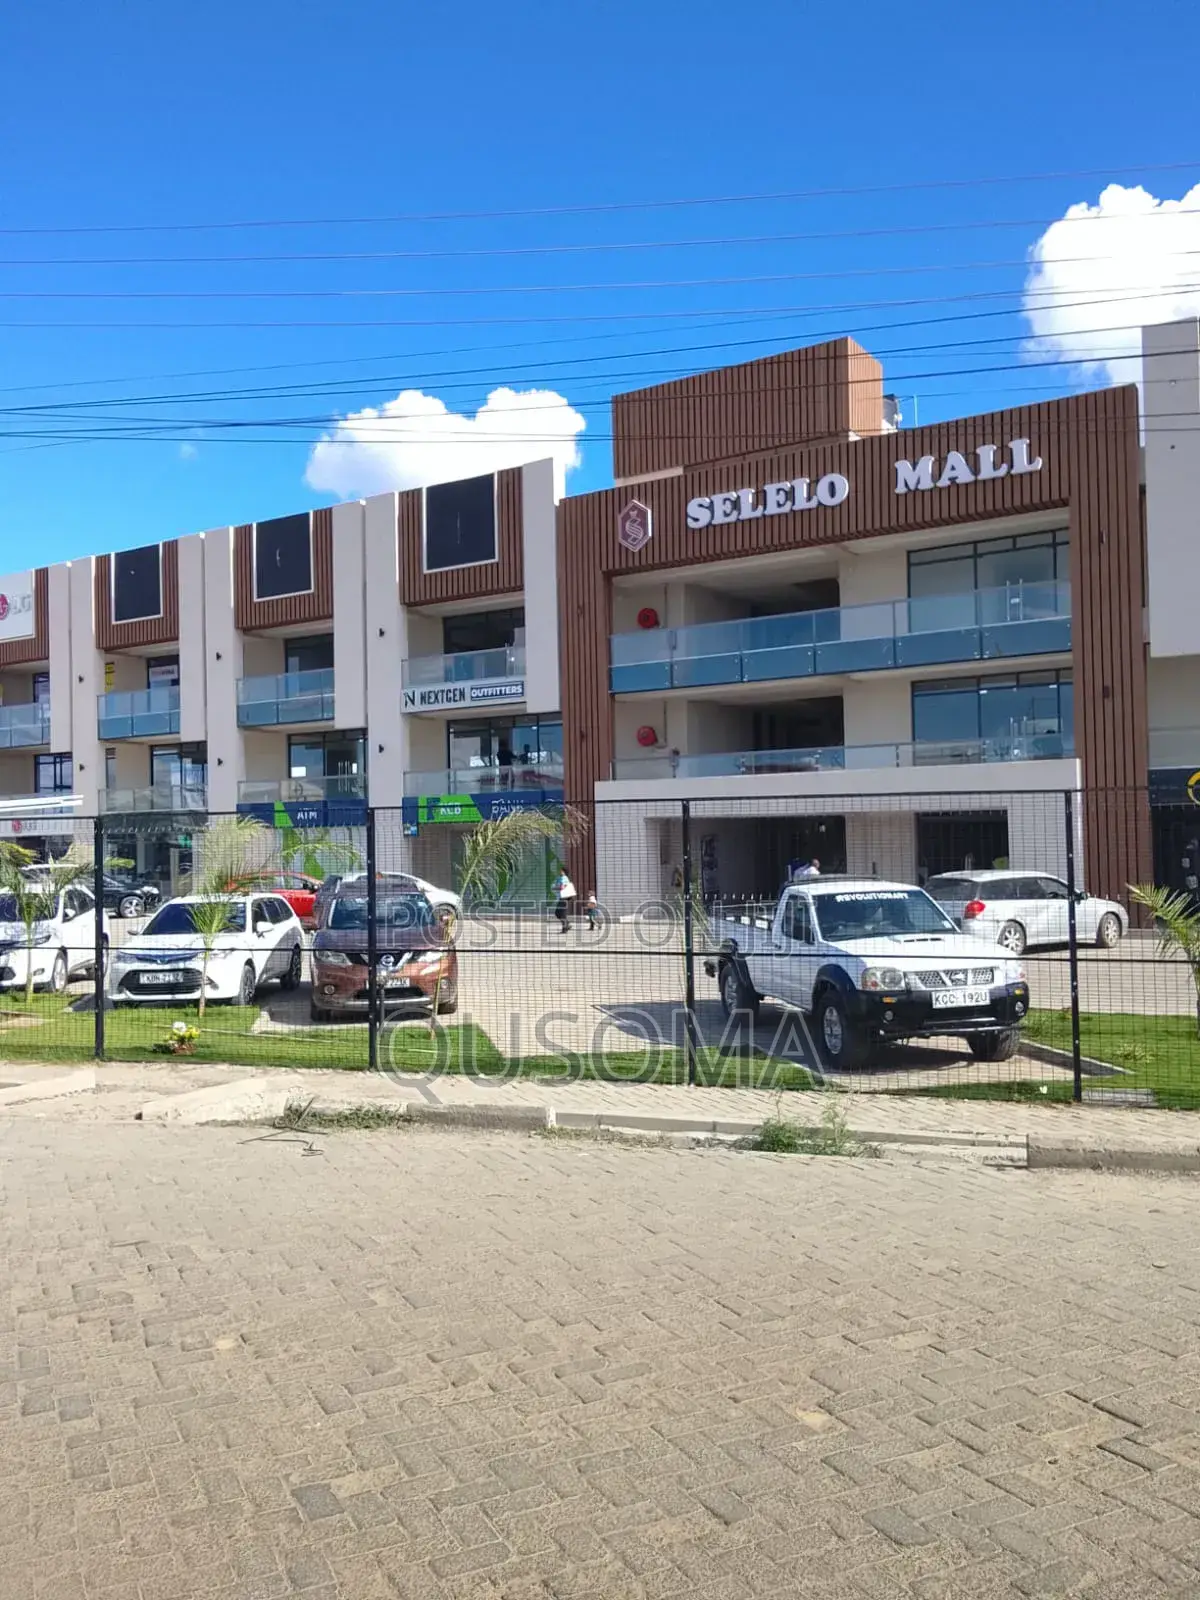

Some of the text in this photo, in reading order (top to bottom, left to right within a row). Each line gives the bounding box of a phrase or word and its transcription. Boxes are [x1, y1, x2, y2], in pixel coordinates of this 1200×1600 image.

[687, 438, 1043, 529] SELELO MALL
[420, 685, 523, 705] NEXTGEN OUTFITTERS
[296, 807, 318, 820] ATM
